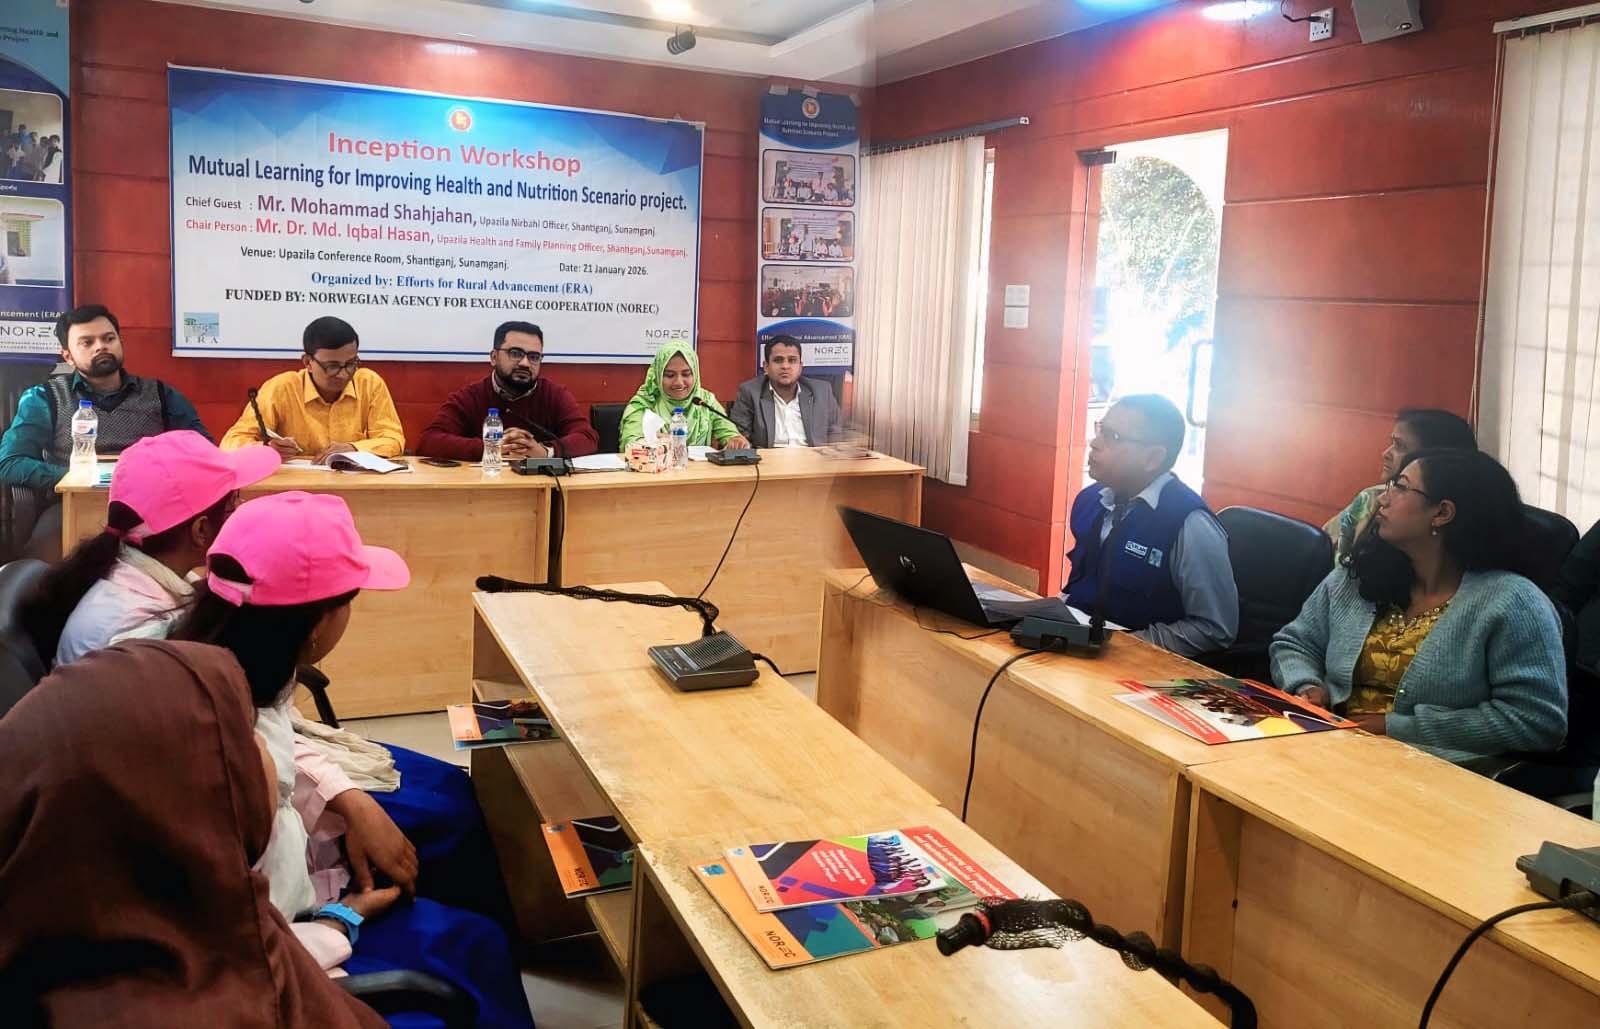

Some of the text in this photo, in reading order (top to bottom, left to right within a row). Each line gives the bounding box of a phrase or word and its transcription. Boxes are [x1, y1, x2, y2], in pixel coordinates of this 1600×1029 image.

[328, 132, 582, 177] Inception Workshop
[188, 155, 688, 212] Mutual Learning for Improving Health and Nutrition Scenario project.
[185, 196, 211, 208] Chief
[213, 198, 242, 210] Guest
[257, 194, 285, 213] Mr.
[291, 197, 389, 218] Mohammad
[394, 203, 477, 227] Shahjahan,
[479, 216, 510, 229] Upazila
[511, 218, 540, 230] Nirbahi
[542, 220, 570, 232] Officer,
[186, 219, 213, 232] Chair
[214, 221, 247, 233] Person
[256, 218, 282, 234] Mr.
[287, 220, 307, 235] Dr.
[312, 221, 341, 238] Md.
[347, 222, 383, 241] Iqbal
[388, 226, 434, 246] Hasan,
[437, 234, 468, 247] Upazila
[469, 236, 497, 247] Health
[499, 237, 514, 248] and
[515, 238, 541, 251] Family
[542, 240, 577, 253] Planning
[241, 246, 509, 271] Venue: Upazila Conference Room, Shantiganj, Sunamganj.
[559, 262, 648, 276] Date: 21 January 2026.
[311, 271, 593, 295] Organized by: Efforts for Rural Advancement (ERA)
[225, 288, 659, 315] FUNDED BY: NORWEGIAN AGENCY FOR EXCHANGE COOPERATION (NOREC)
[645, 329, 689, 339] NOREC
[765, 930, 797, 958] NOREC
